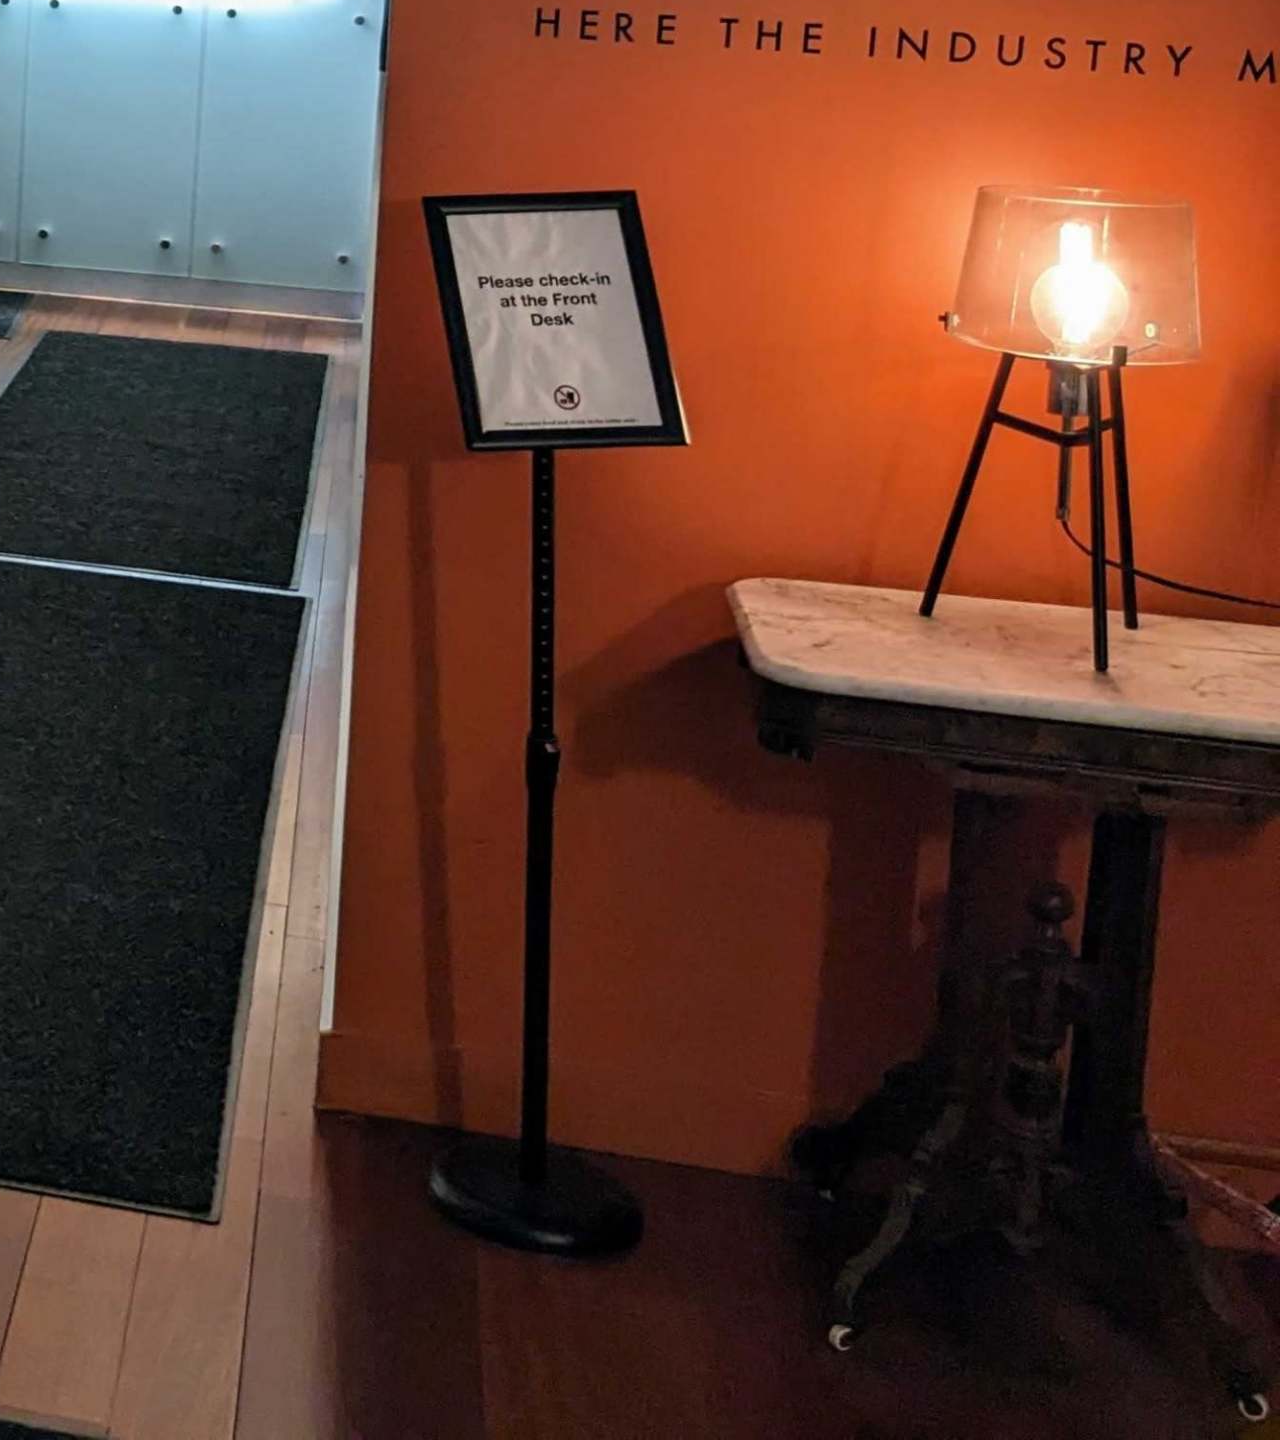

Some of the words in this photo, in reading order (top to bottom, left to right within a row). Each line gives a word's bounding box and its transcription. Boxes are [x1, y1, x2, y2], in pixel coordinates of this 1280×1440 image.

[535, 7, 676, 45] HERE
[718, 17, 823, 55] THE
[867, 26, 1192, 77] INDUSTRY
[1238, 49, 1277, 84] M
[477, 275, 534, 289] Please
[539, 272, 611, 287] check-in
[500, 294, 517, 308] at
[521, 292, 548, 306] the
[553, 291, 597, 306] Front
[530, 312, 574, 327] Desk
